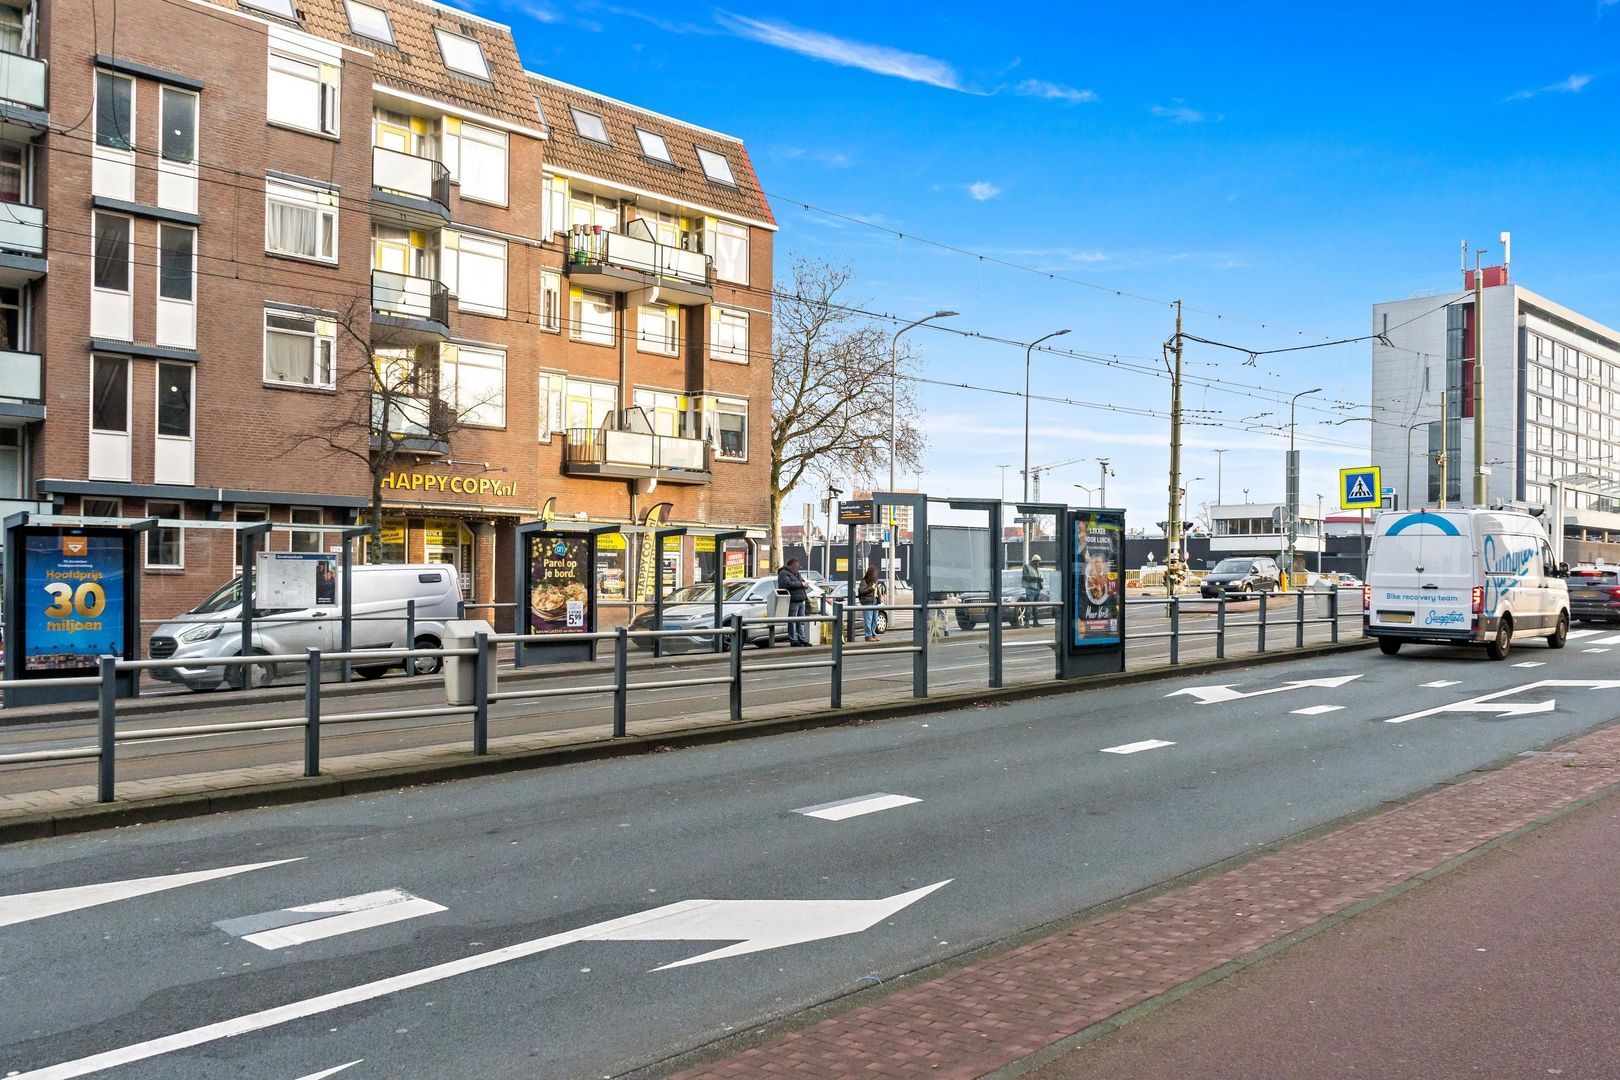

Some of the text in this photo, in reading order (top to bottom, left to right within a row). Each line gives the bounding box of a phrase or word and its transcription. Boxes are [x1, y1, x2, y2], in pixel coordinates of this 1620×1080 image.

[543, 558, 577, 571] Parel op
[46, 570, 103, 580] Hoofdprijs
[543, 569, 576, 580] je bord.
[43, 582, 106, 619] 30
[1386, 592, 1401, 600] Bike
[1402, 594, 1436, 602] recovery
[1425, 610, 1464, 625] Swapfiets
[47, 620, 102, 633] miljoen
